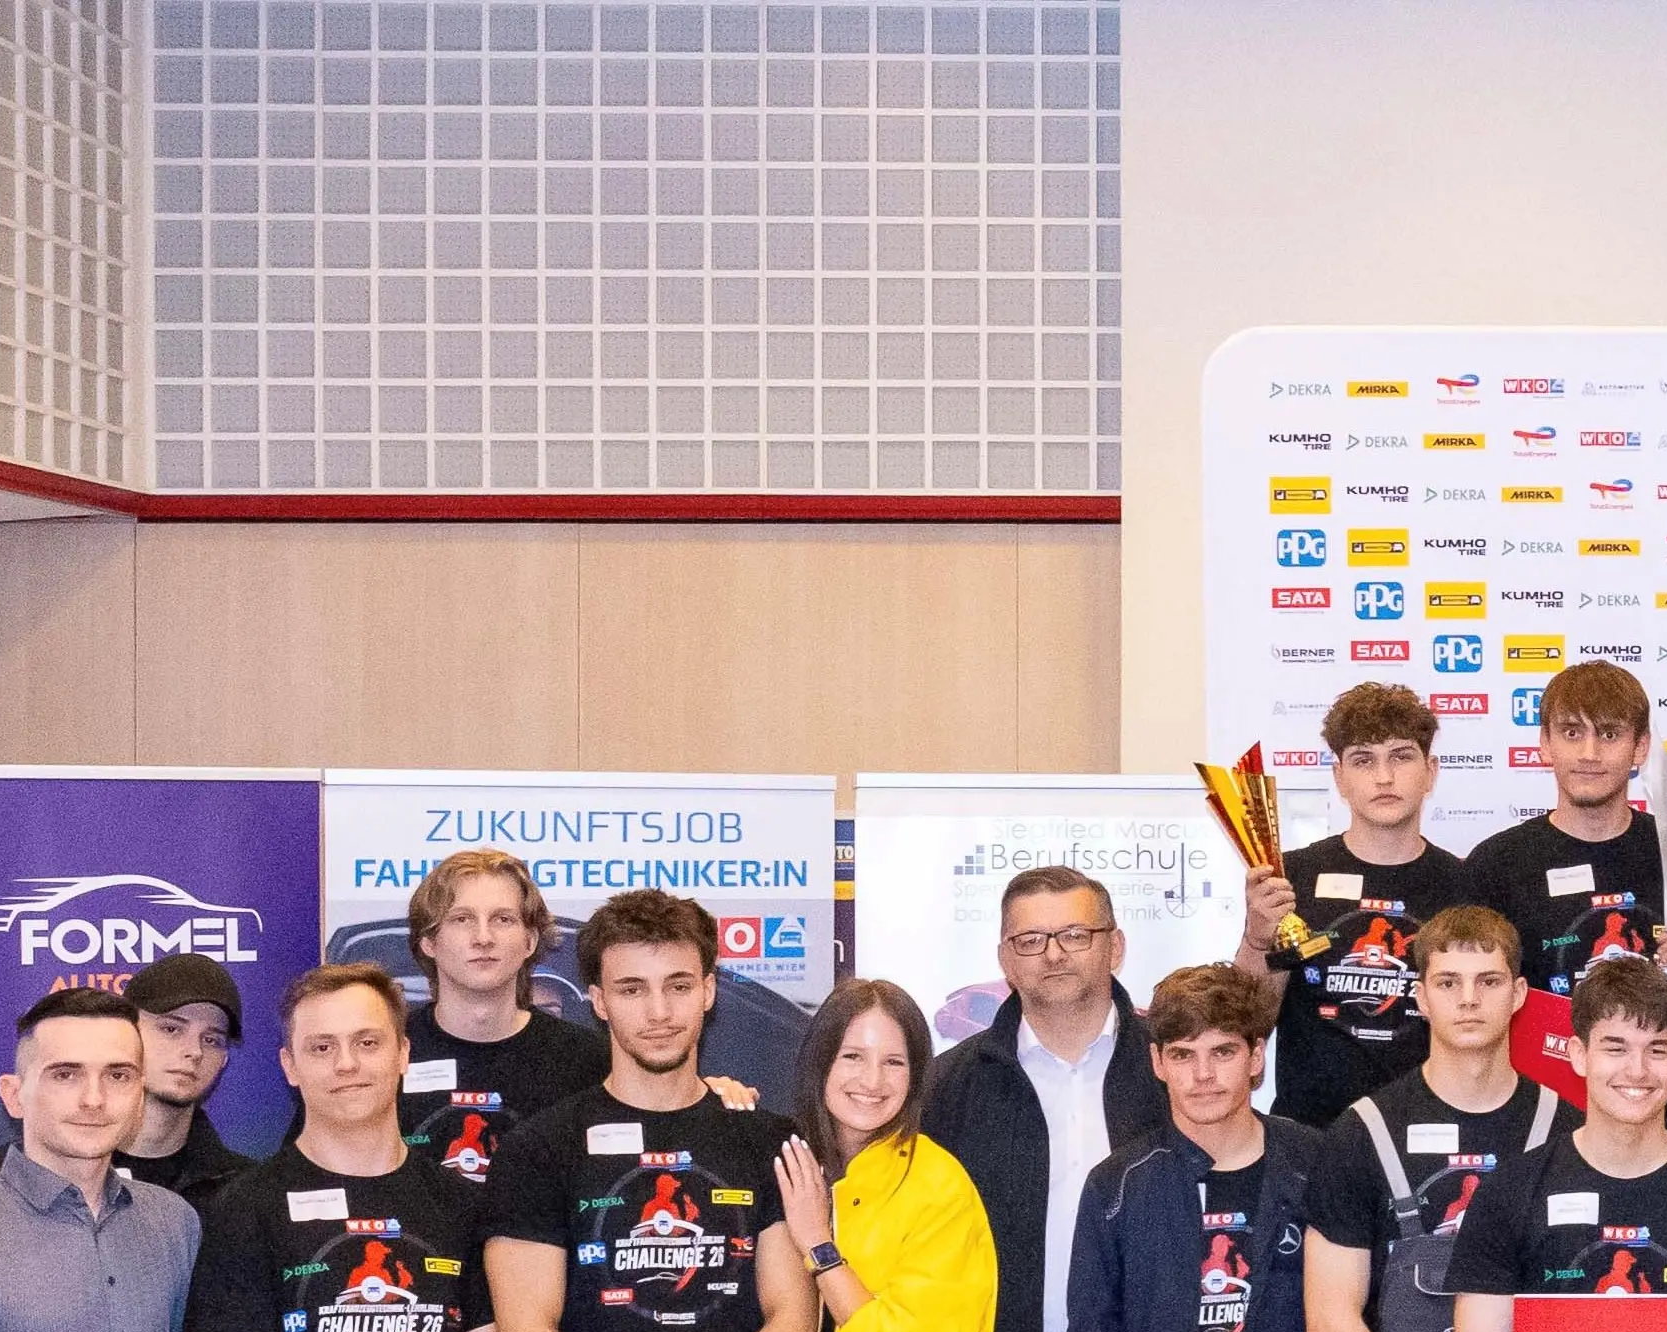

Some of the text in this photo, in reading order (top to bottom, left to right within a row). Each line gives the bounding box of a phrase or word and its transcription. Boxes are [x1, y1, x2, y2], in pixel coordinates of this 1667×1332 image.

[1289, 384, 1331, 395] DEKRA
[1270, 434, 1331, 442] KUMHO
[1433, 438, 1475, 446] MIRKA
[1347, 486, 1408, 494] KUMHO
[1444, 490, 1485, 500] DEKRA
[1280, 533, 1323, 563] PPG
[1278, 592, 1325, 604] SATA
[1359, 585, 1400, 616] PPG
[1502, 591, 1563, 600] KUMHO
[1598, 595, 1640, 606] DEKRA
[1357, 645, 1403, 657] SATA
[1437, 638, 1479, 668] PPG
[426, 809, 743, 844] ZUKUNFTSJOB
[991, 841, 1208, 872] Berufsschule
[354, 858, 808, 888] FAHGTECHNIKER:IN
[1590, 893, 1623, 907] WKO
[20, 917, 258, 966] FORMEL
[1325, 974, 1409, 998] CHALLENGE
[450, 1092, 486, 1105] WKO
[640, 1151, 677, 1165] WKO
[1447, 1154, 1483, 1167] WKO
[591, 1196, 625, 1208] DEKRA
[345, 1219, 385, 1232] WKO
[1603, 1226, 1638, 1240] WKO
[578, 1244, 607, 1265] PPG
[613, 1245, 725, 1272] CHALLENGE 26
[294, 1263, 330, 1277] DEKRA
